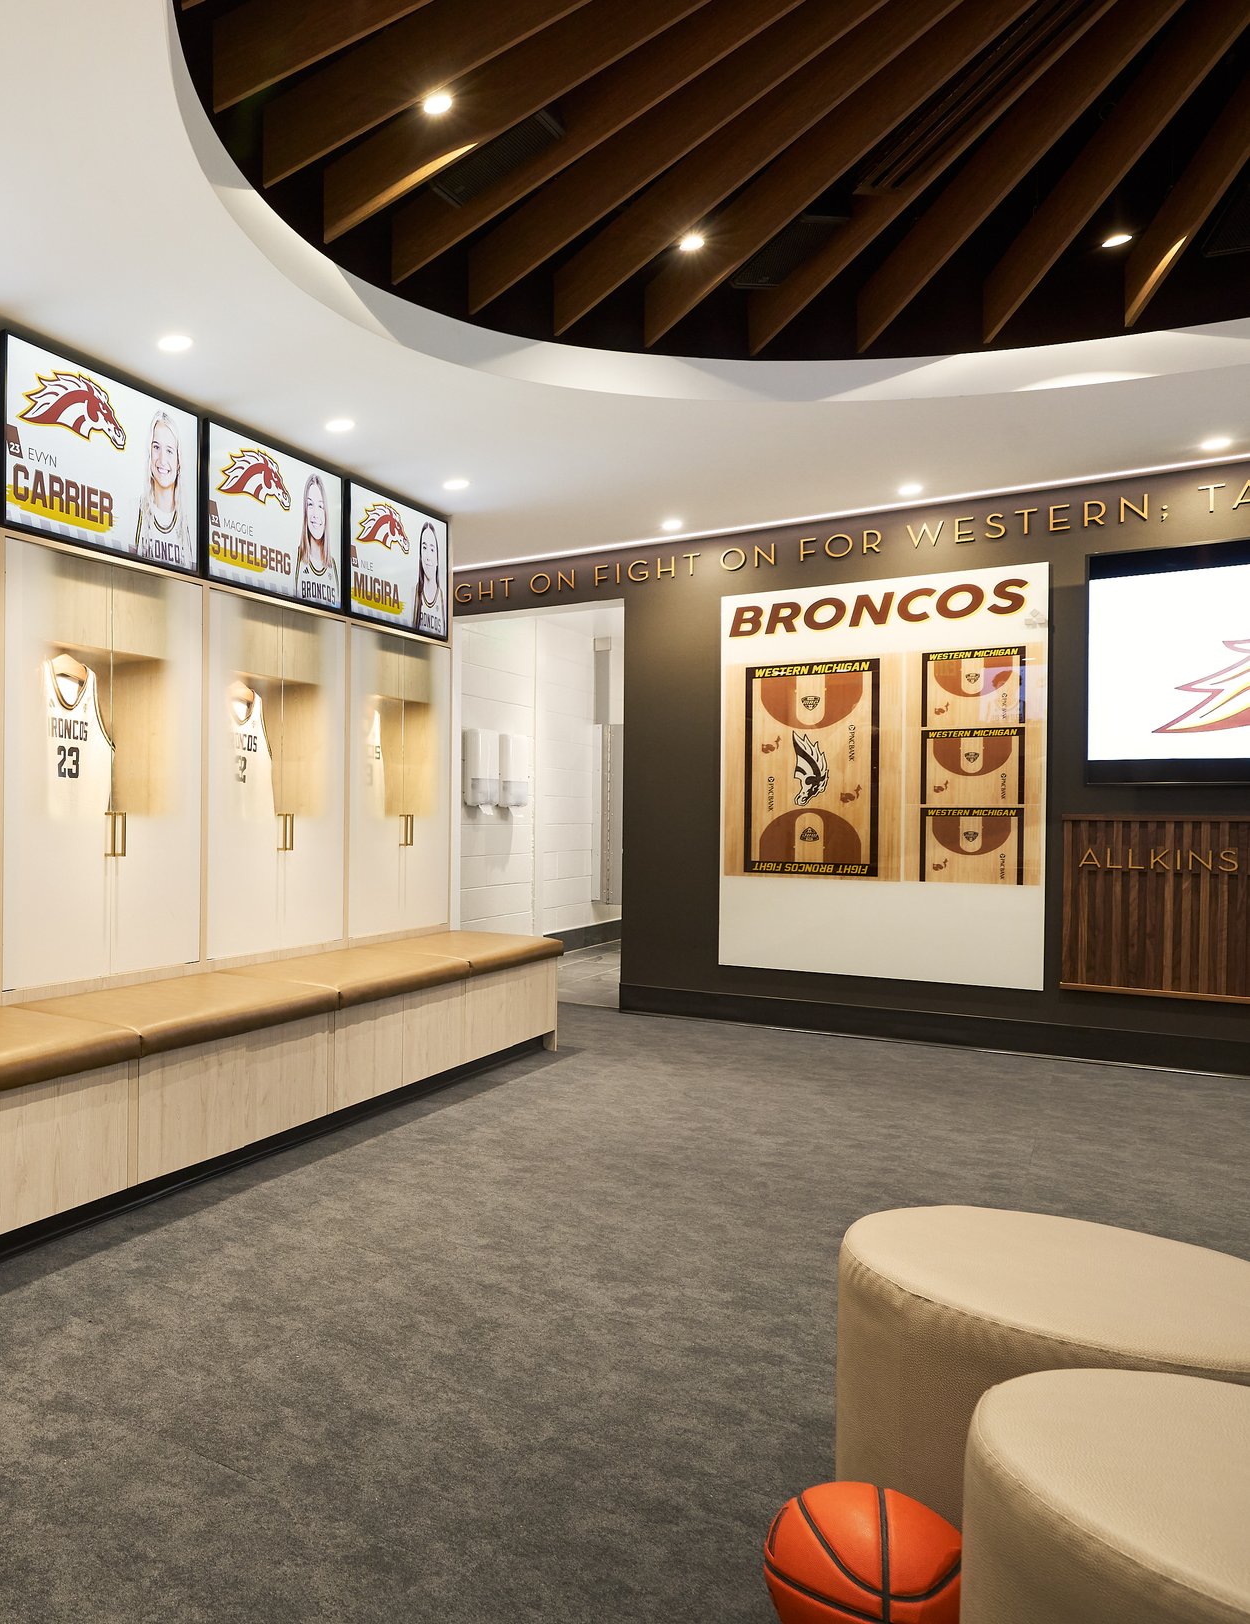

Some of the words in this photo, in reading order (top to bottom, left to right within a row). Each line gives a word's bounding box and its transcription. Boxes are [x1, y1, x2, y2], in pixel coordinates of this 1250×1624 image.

[9, 440, 21, 454] 23
[28, 447, 57, 468] EVYN
[13, 463, 114, 527] CARRIER
[223, 517, 254, 537] MAGGIE
[211, 530, 292, 576] STUTELBERG
[529, 568, 576, 595] ON
[594, 552, 701, 588] FIGHT
[720, 543, 777, 572] ON
[799, 529, 883, 562] FOR
[906, 493, 1170, 549] WESTERN;
[360, 559, 374, 572] NILE
[301, 580, 336, 606] BRONCOS
[353, 571, 401, 610] MUGIRA
[729, 578, 1030, 638] BRONCOS
[420, 611, 441, 633] RONCOS
[929, 651, 972, 660] WESTERN
[973, 648, 1019, 658] MICHIGAN
[755, 665, 810, 678] WESTERN
[812, 661, 870, 674] MICHIGAN
[48, 716, 89, 742] RONCOS
[928, 730, 971, 738] WESTERN
[972, 729, 1017, 737] MICHIGAN
[57, 745, 80, 779] 23
[752, 862, 783, 872] FIGHT
[784, 863, 835, 873] BRONCOS
[836, 864, 869, 875] FIGHT
[1079, 848, 1240, 872] ALLKINS
